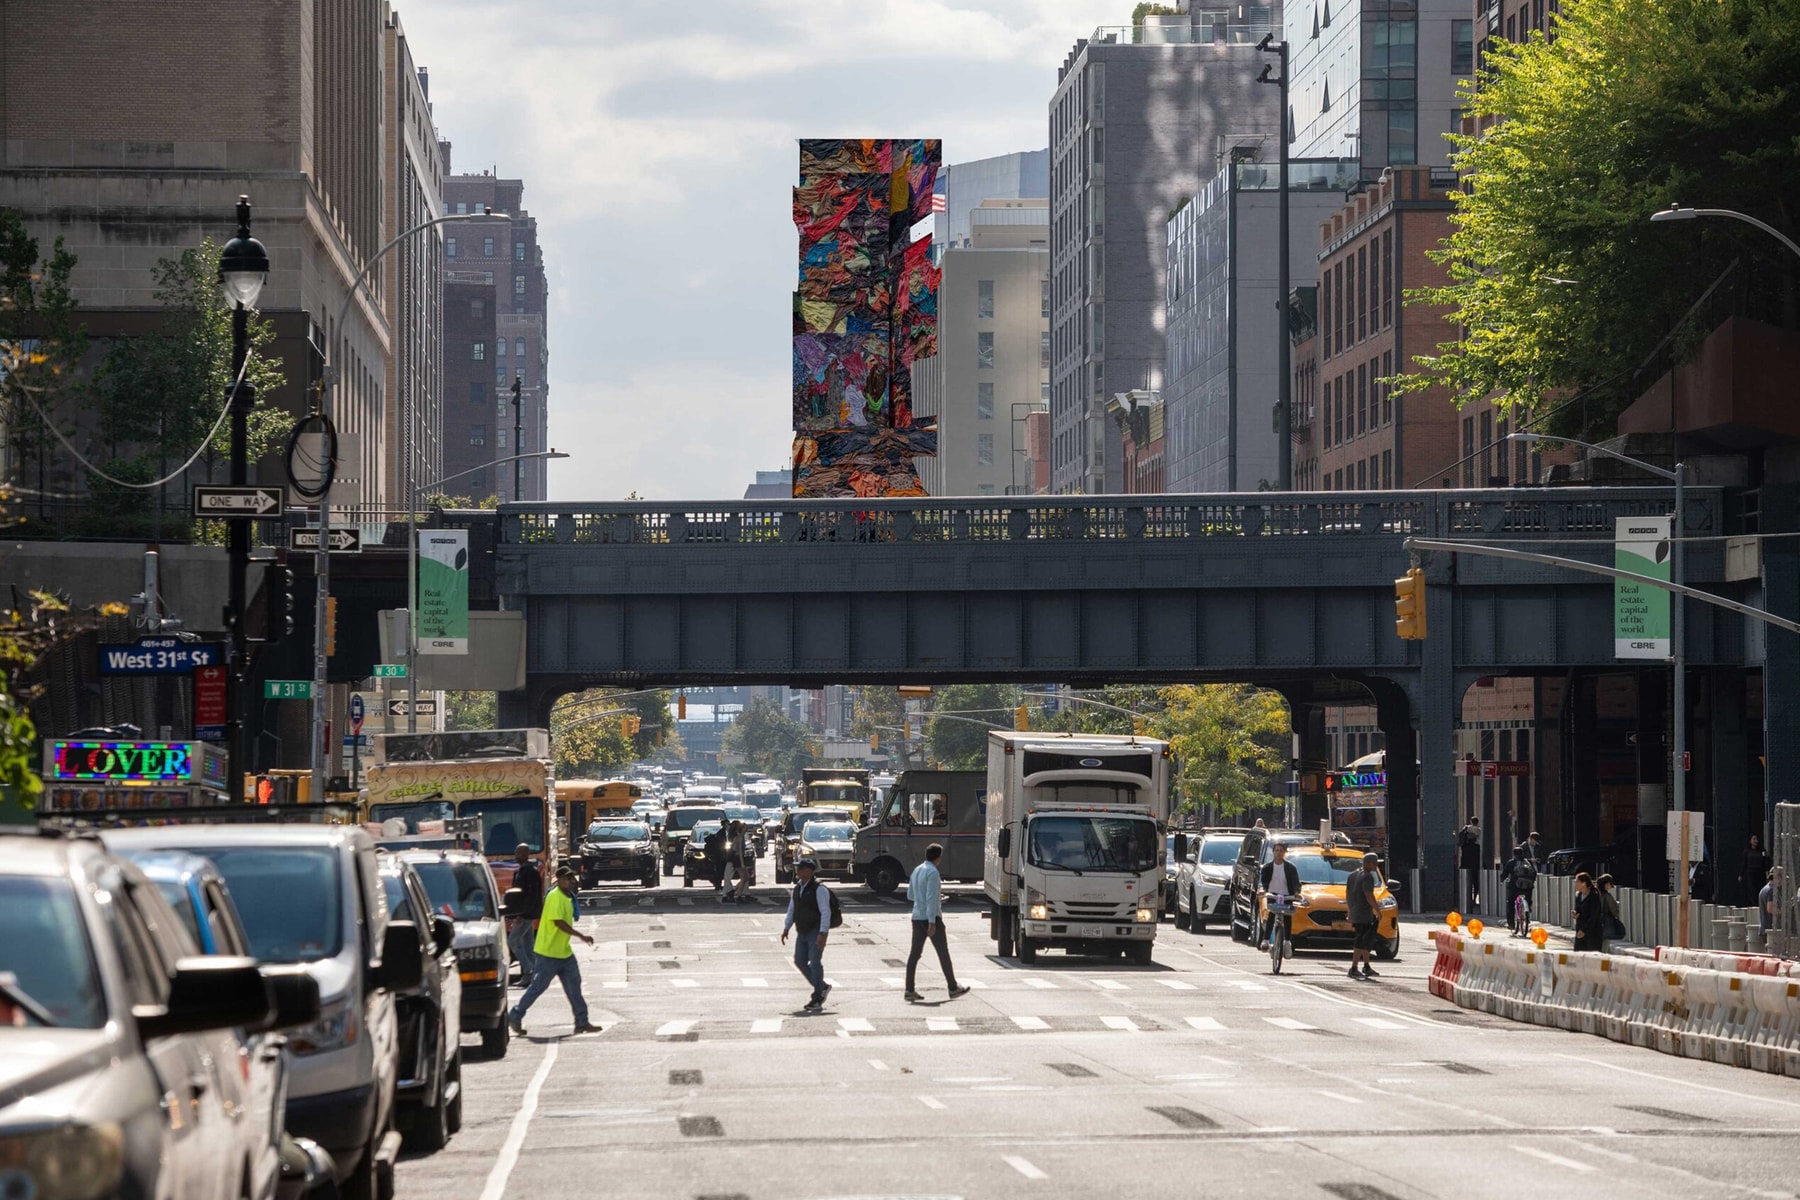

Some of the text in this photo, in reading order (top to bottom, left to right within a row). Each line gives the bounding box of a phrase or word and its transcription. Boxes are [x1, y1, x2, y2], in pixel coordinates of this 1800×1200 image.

[209, 497, 269, 507] ONE WAY
[301, 535, 350, 545] ONE WAY
[1620, 585, 1639, 594] Real
[1620, 596, 1645, 604] estate
[423, 608, 449, 617] capital
[1620, 606, 1648, 615] capital
[1620, 625, 1645, 633] world
[108, 651, 210, 669] West 31st St
[376, 667, 383, 676] W
[385, 666, 397, 676] 30
[271, 683, 306, 696] W 31 St
[87, 749, 187, 774] OVER
[1341, 773, 1387, 786] ANDWI
